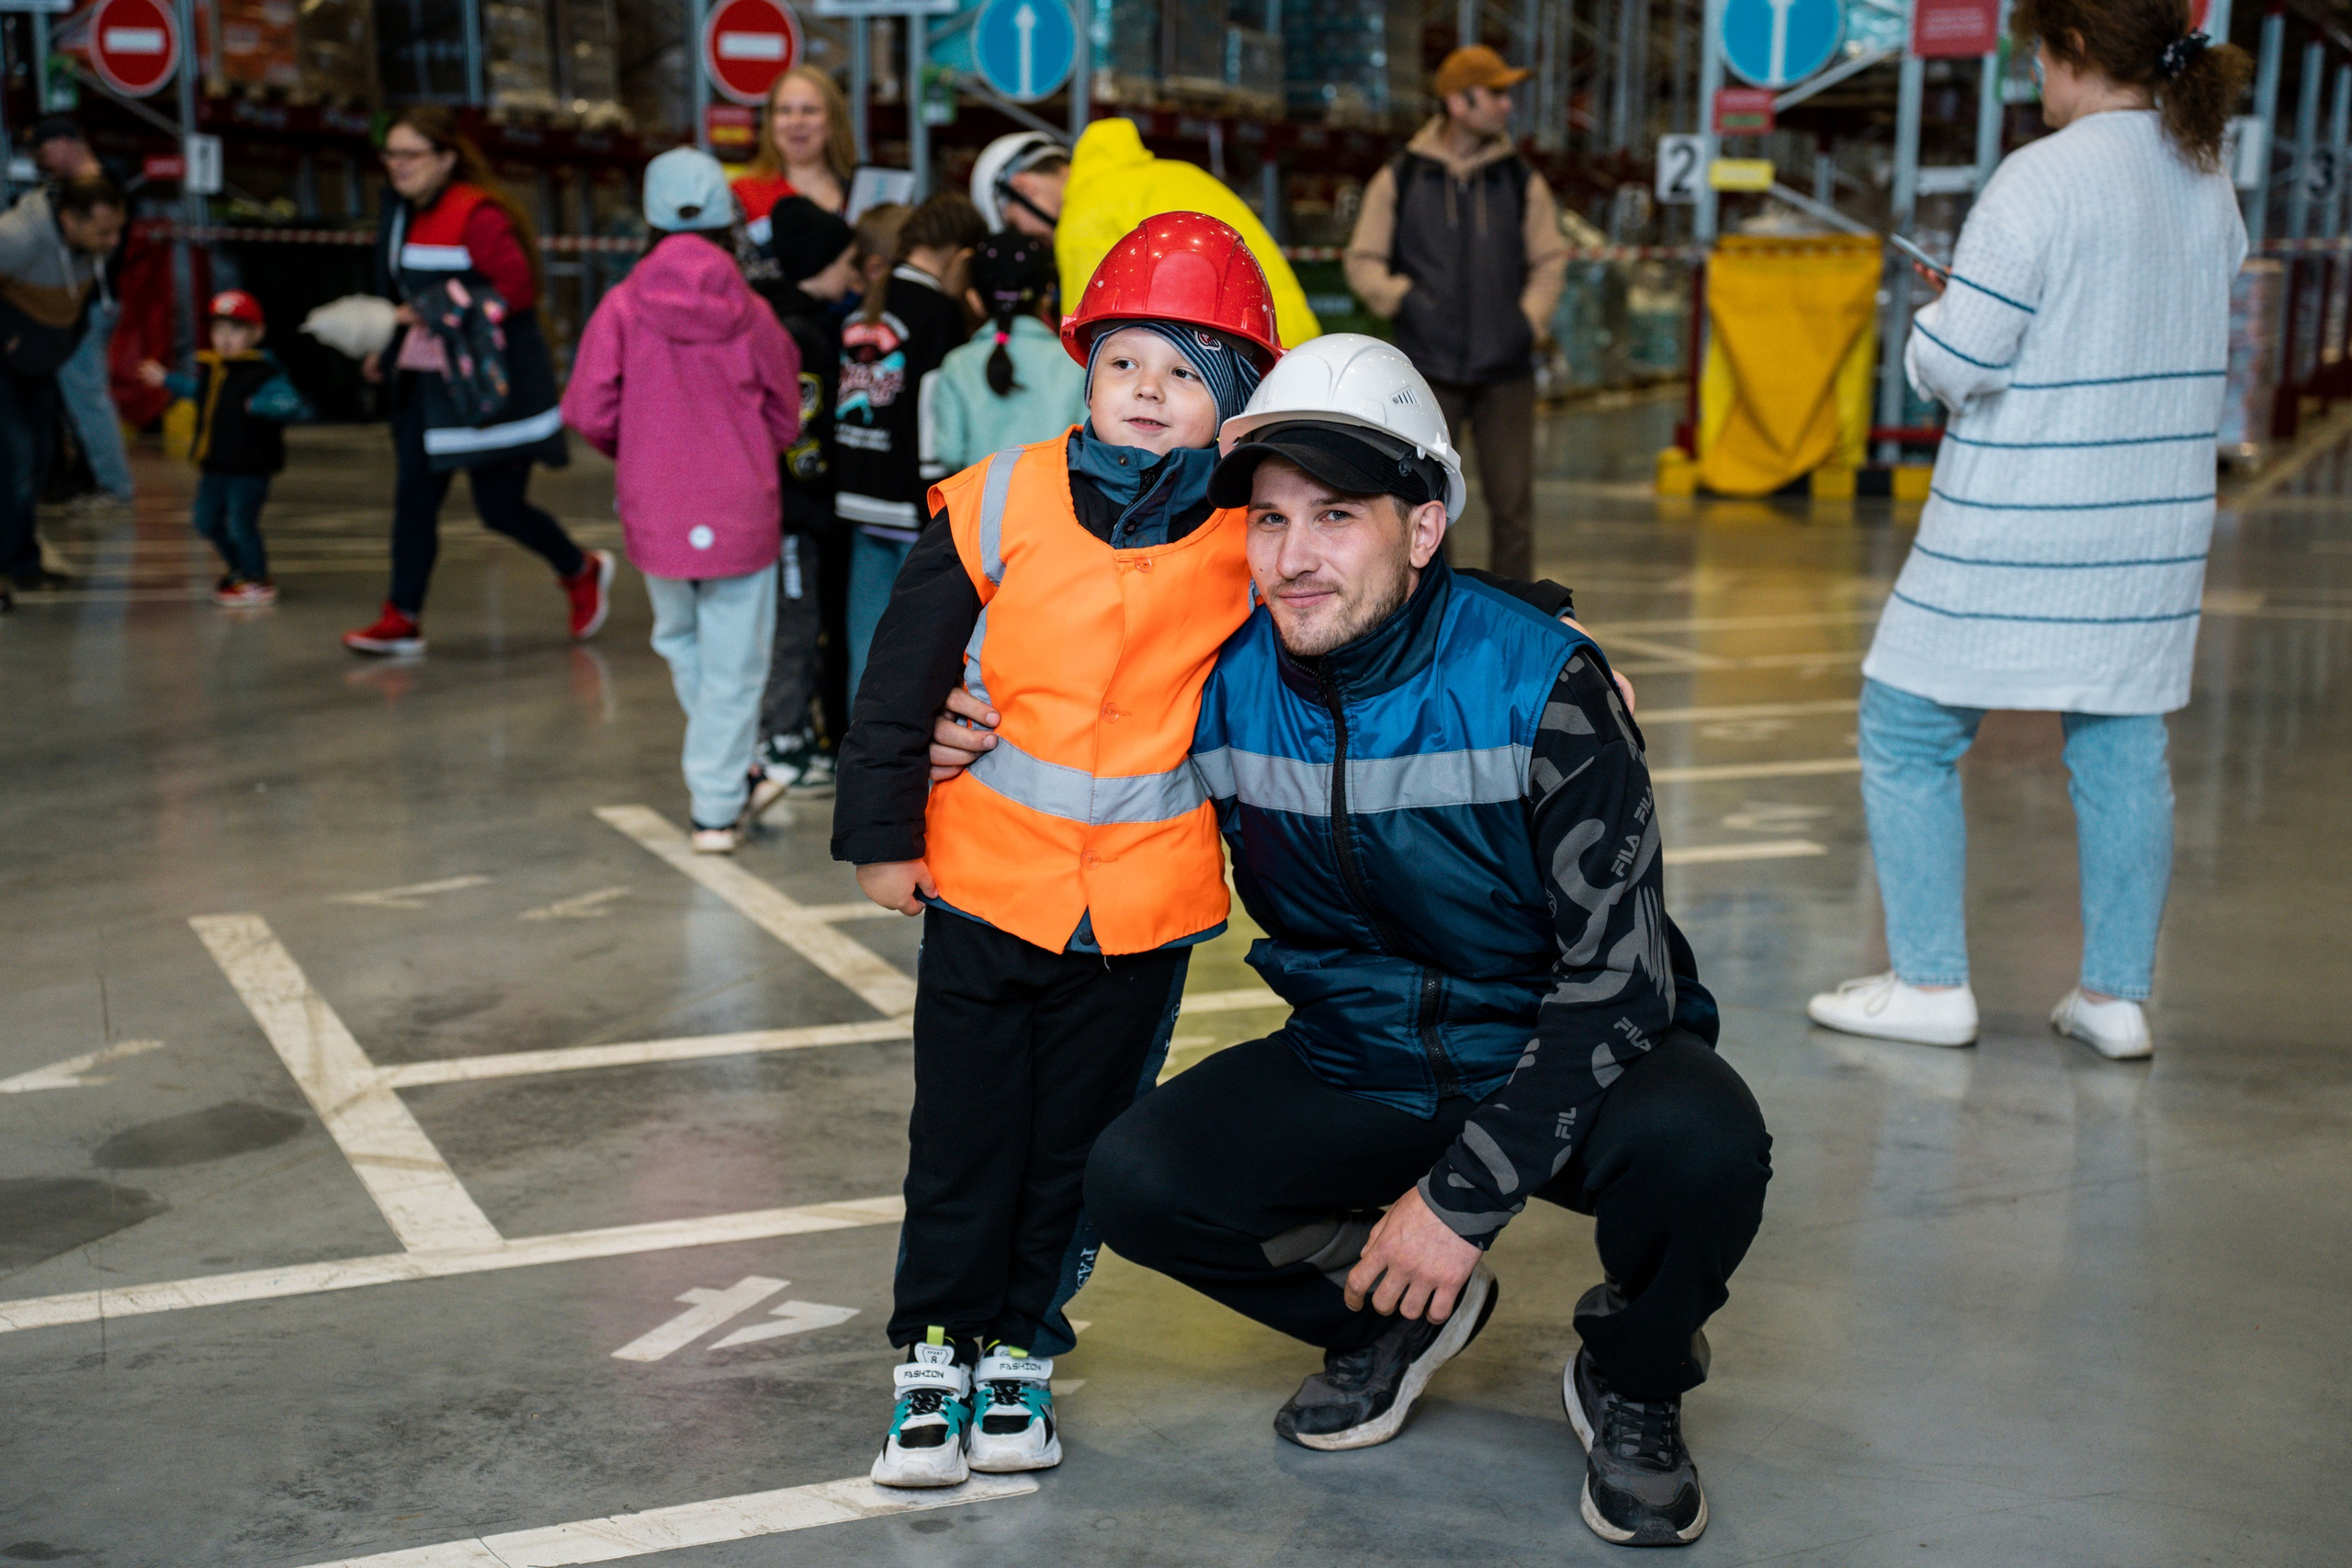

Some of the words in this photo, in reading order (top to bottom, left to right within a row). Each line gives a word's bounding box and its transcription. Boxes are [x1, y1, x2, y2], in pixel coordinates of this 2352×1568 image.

[1669, 141, 1697, 192] 2
[1634, 785, 1654, 826] FILA
[1611, 835, 1641, 877] FILA
[1613, 1016, 1652, 1052] FILA
[1555, 1107, 1577, 1140] FIL
[903, 1370, 944, 1379] FASHION
[1000, 1362, 1042, 1371] FASHION
